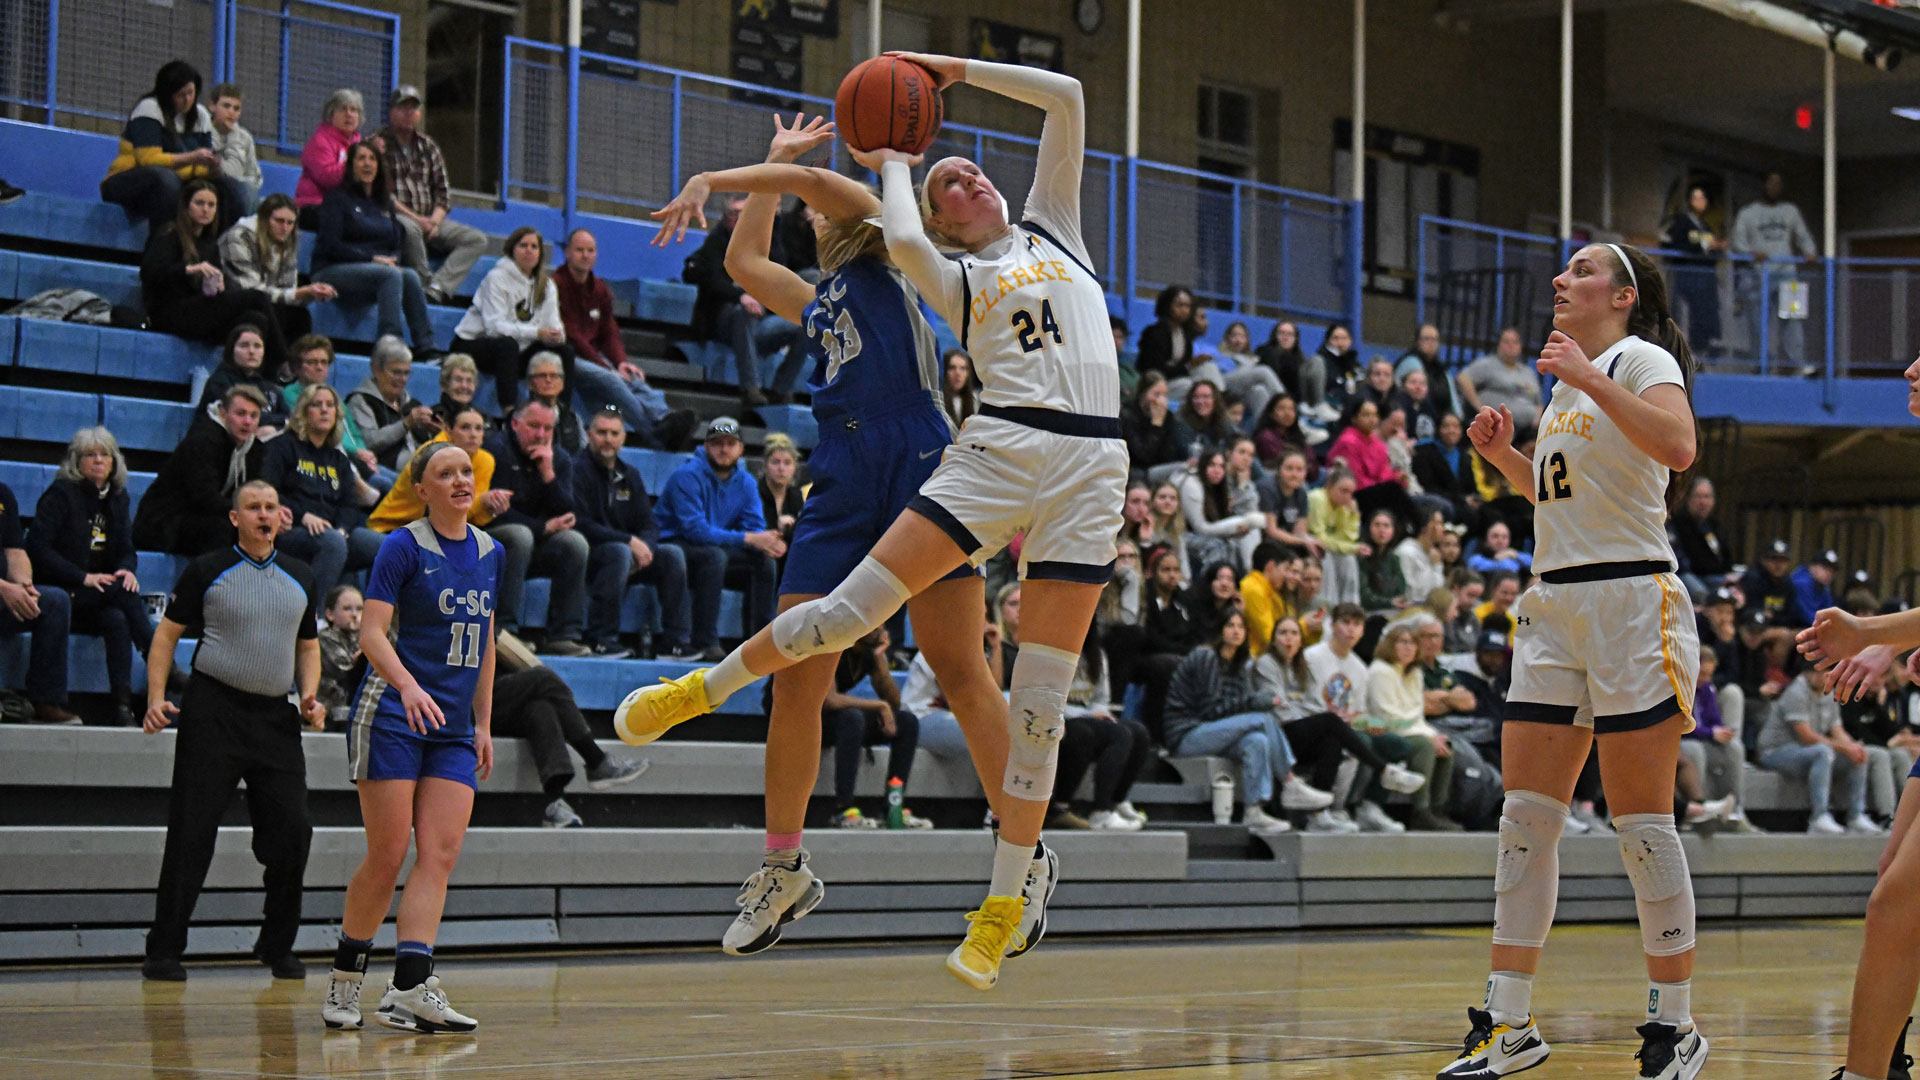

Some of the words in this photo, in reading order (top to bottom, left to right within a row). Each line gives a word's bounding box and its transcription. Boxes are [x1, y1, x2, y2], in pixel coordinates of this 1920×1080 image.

[970, 260, 1073, 324] CLARKE
[821, 308, 862, 384] 33
[1009, 296, 1065, 355] 24
[1537, 411, 1595, 444] ARKE
[1537, 449, 1574, 504] 12
[438, 588, 491, 617] C-SC
[446, 622, 481, 668] 11
